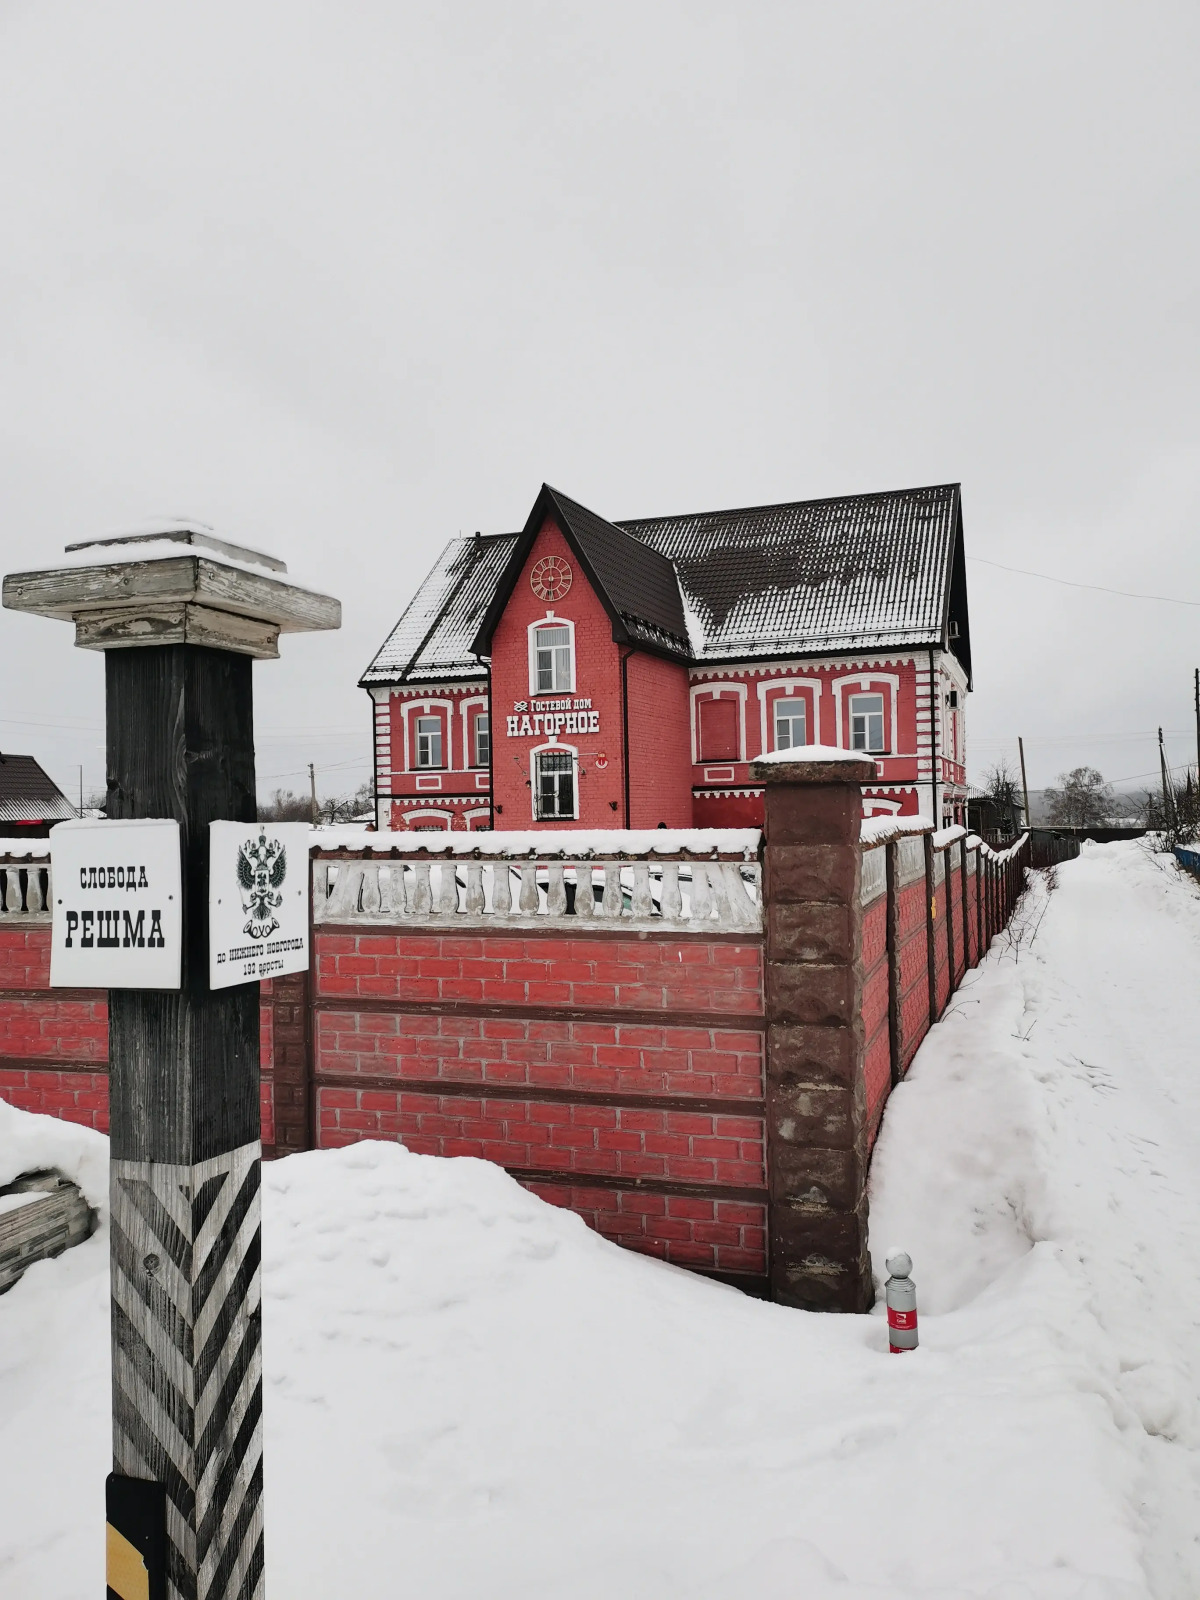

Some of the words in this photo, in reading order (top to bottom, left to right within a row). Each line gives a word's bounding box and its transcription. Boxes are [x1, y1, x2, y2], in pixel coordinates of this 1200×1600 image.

[506, 711, 600, 737] НАГОРНОЕ
[80, 866, 149, 892] СЛОБОДА
[65, 910, 165, 949] РЕШМА
[229, 944, 263, 961] НИЖНЕГО
[266, 938, 304, 955] НОВГОРОДА
[243, 962, 256, 976] 192
